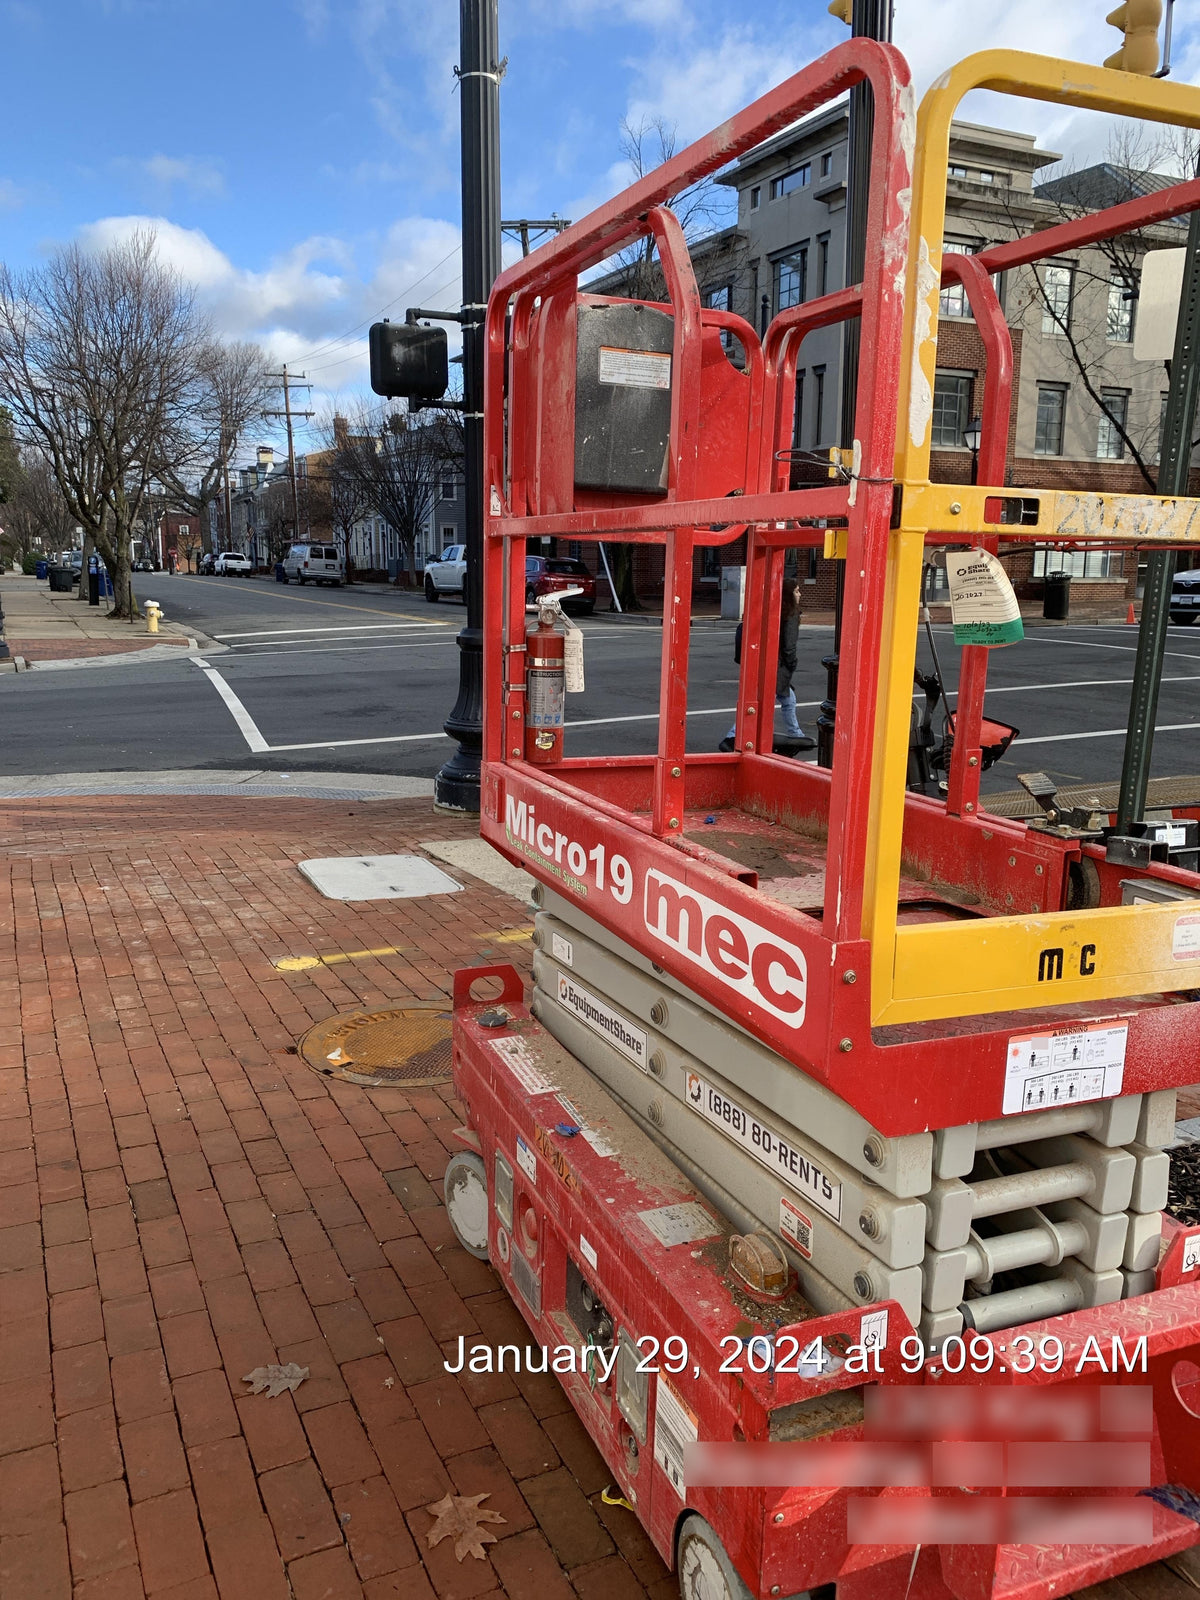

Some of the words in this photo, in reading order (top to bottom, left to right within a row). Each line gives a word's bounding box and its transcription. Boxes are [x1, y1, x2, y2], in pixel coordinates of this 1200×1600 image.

[506, 793, 633, 905] Micro19
[563, 870, 588, 896] System
[568, 985, 642, 1055] EquipmentShare
[709, 1089, 746, 1136] (888)
[752, 1122, 833, 1200] 80-RENTS
